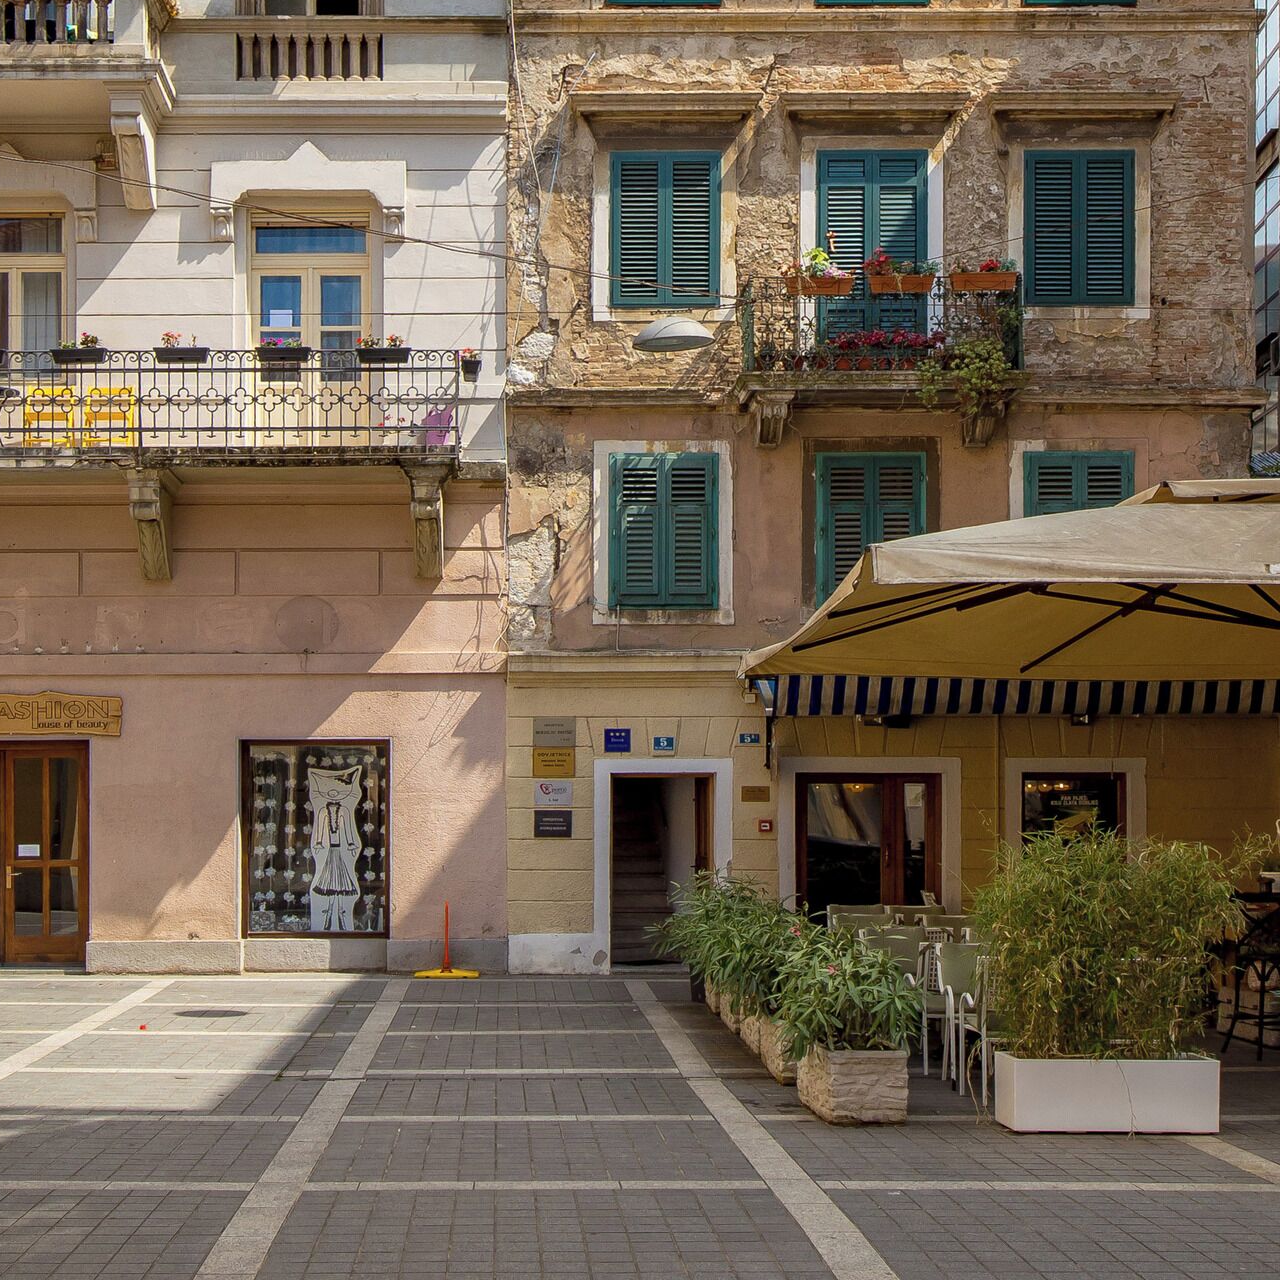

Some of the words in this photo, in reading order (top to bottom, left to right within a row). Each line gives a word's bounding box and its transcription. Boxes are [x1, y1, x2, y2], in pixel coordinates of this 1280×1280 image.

[63, 720, 73, 729] of
[76, 720, 110, 730] beauty
[659, 737, 668, 747] 5
